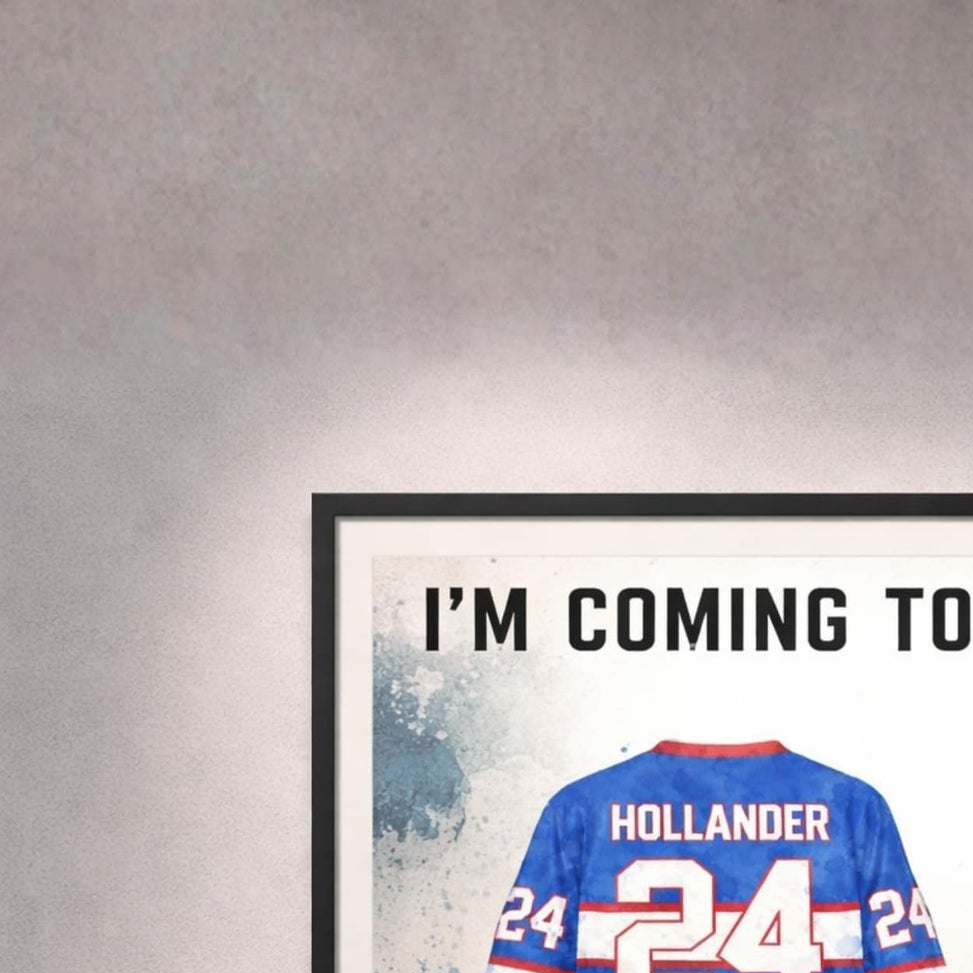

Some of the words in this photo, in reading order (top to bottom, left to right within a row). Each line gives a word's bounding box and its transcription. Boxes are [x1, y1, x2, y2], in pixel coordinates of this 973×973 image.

[426, 587, 527, 651] I'M
[568, 587, 847, 651] COMING
[885, 587, 971, 651] TO
[610, 803, 830, 841] HOLLANDER
[495, 885, 568, 949] 24
